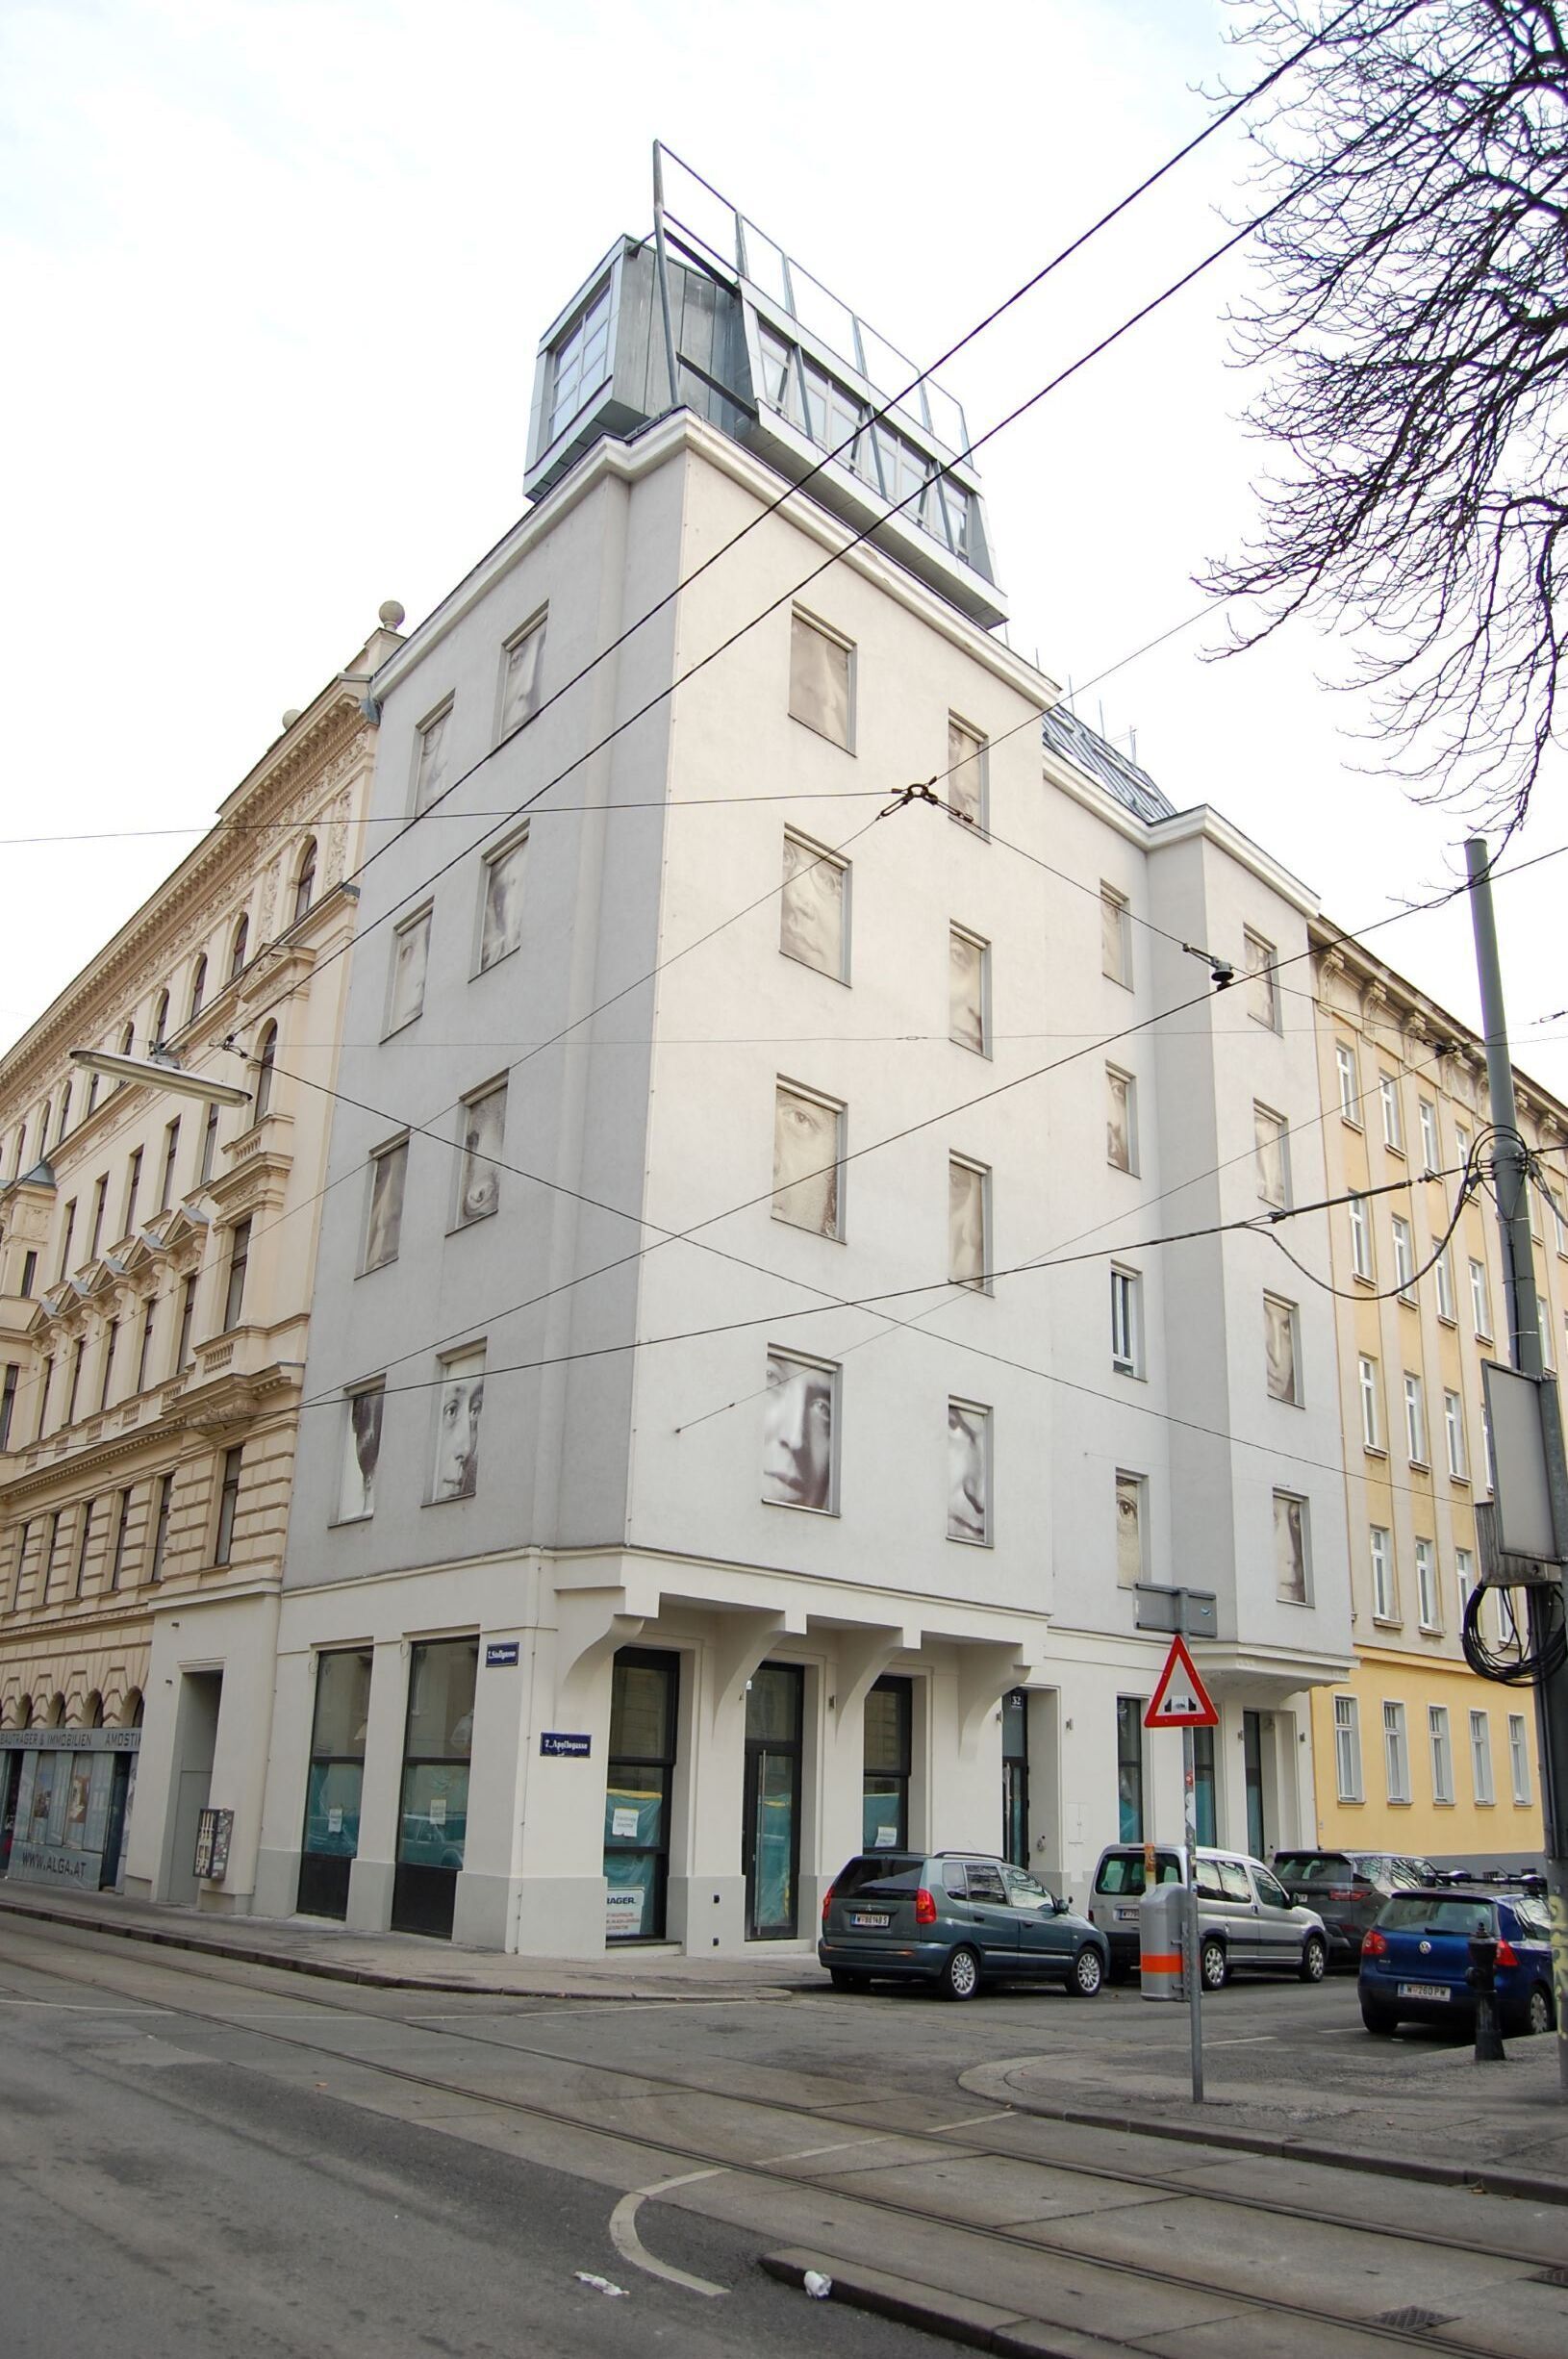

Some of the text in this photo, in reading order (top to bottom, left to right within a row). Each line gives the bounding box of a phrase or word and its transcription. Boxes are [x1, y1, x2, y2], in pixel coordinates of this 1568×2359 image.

[47, 1733, 92, 1747] IMMOBILIEN
[553, 1739, 588, 1752] Apollogasse
[22, 1850, 88, 1879] WWW.ALGA.AT
